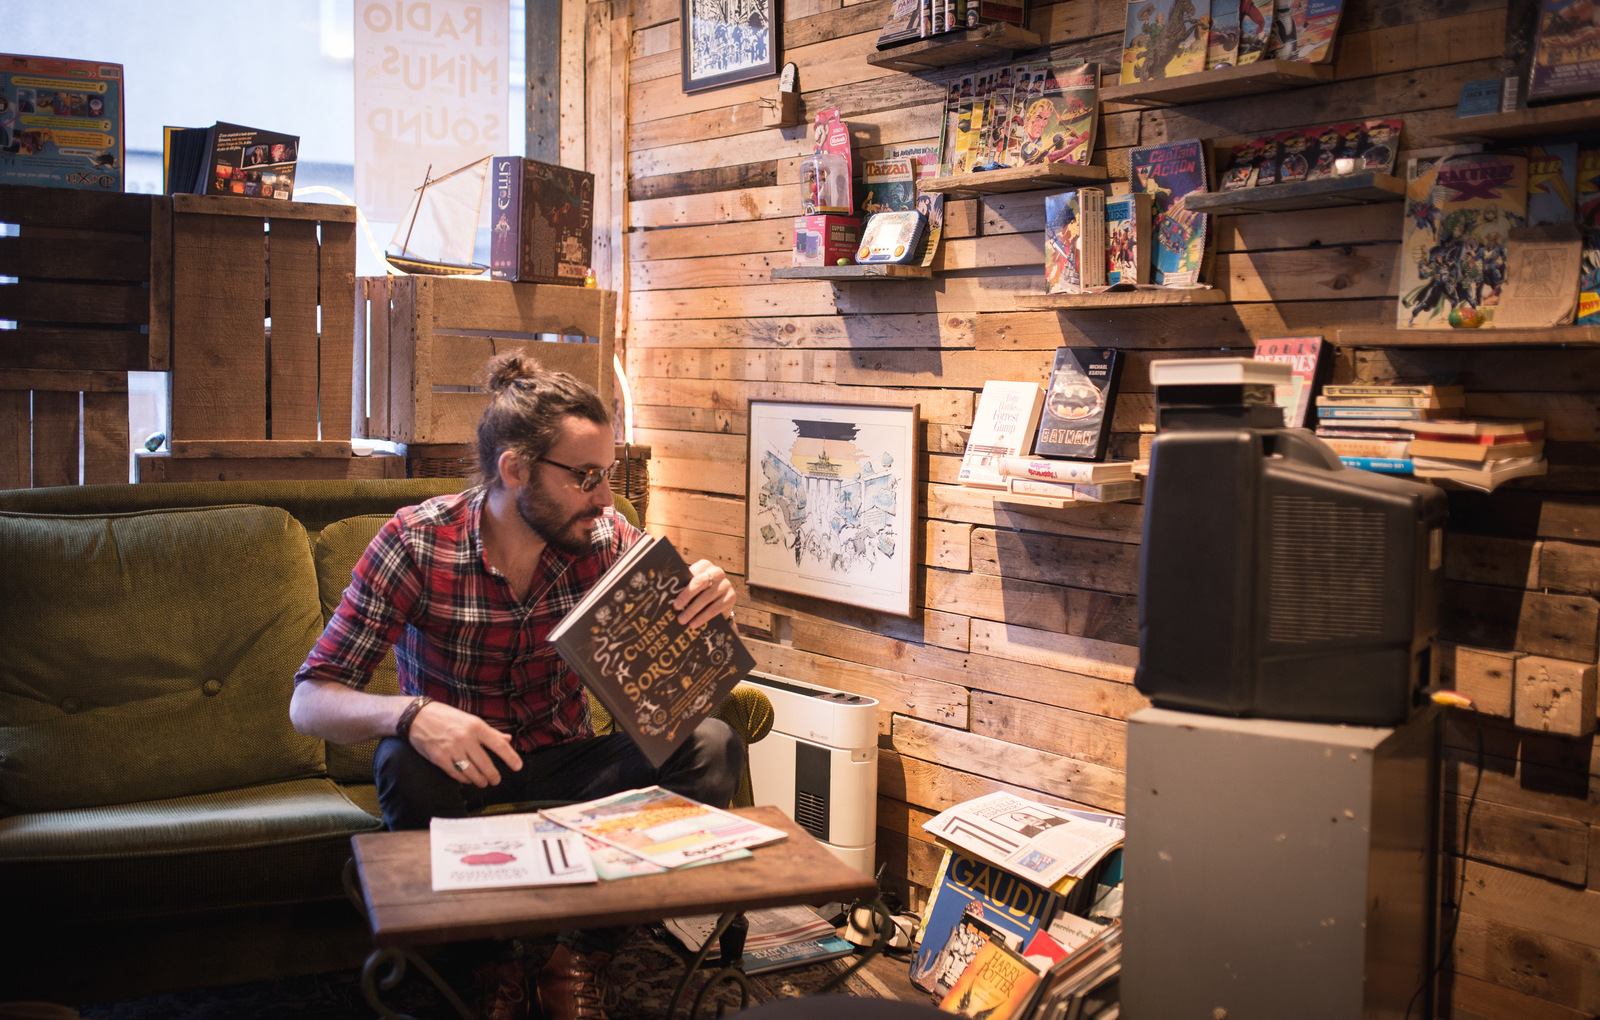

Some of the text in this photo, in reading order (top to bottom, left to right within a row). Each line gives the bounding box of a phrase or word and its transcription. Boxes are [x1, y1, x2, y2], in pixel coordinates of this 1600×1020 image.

[866, 161, 910, 177] Tarzan
[1040, 428, 1093, 445] BATMAN
[624, 610, 675, 662] CUISINE
[631, 616, 650, 635] LA
[648, 634, 670, 658] DES
[951, 855, 1045, 925] GAUDI
[978, 960, 1016, 998] POTTER
[986, 950, 1025, 984] HARRY
